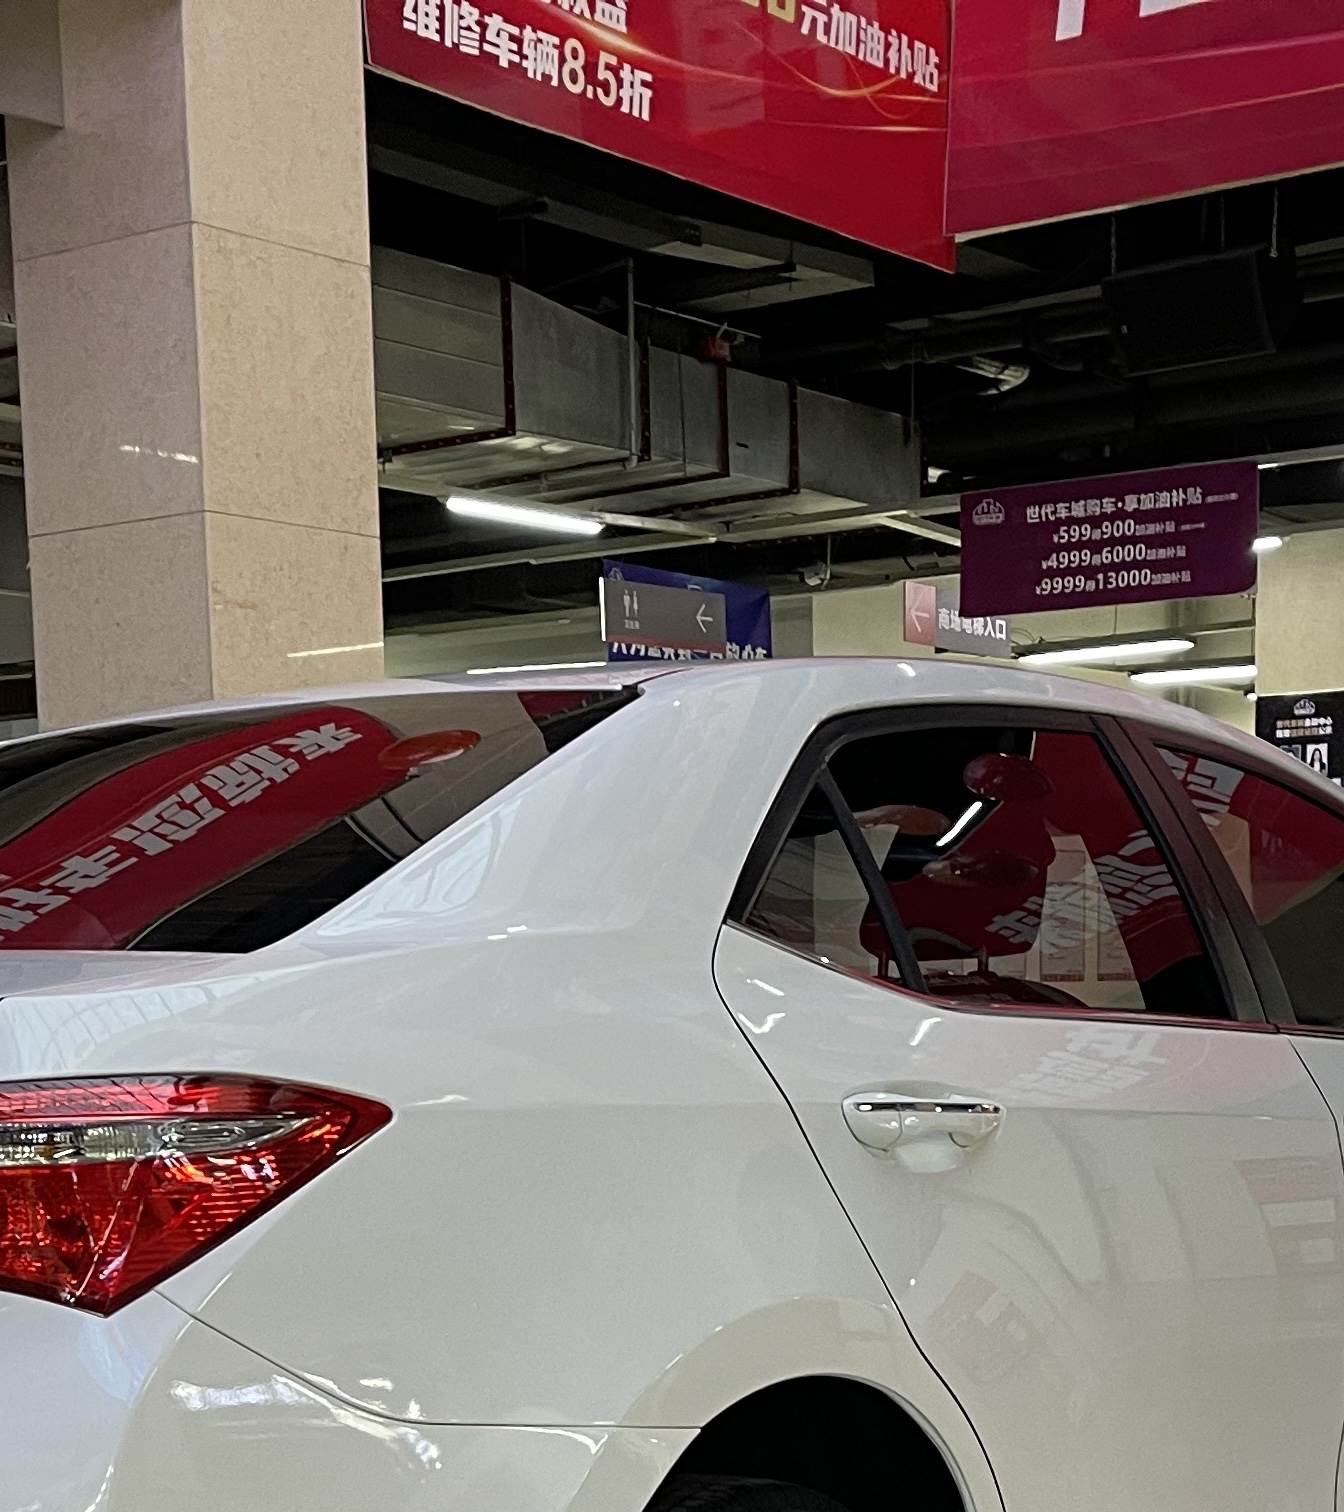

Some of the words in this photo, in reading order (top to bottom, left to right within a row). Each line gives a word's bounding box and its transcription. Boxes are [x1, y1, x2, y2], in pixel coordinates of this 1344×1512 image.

[402, 0, 653, 121] 维修车辆8.5折
